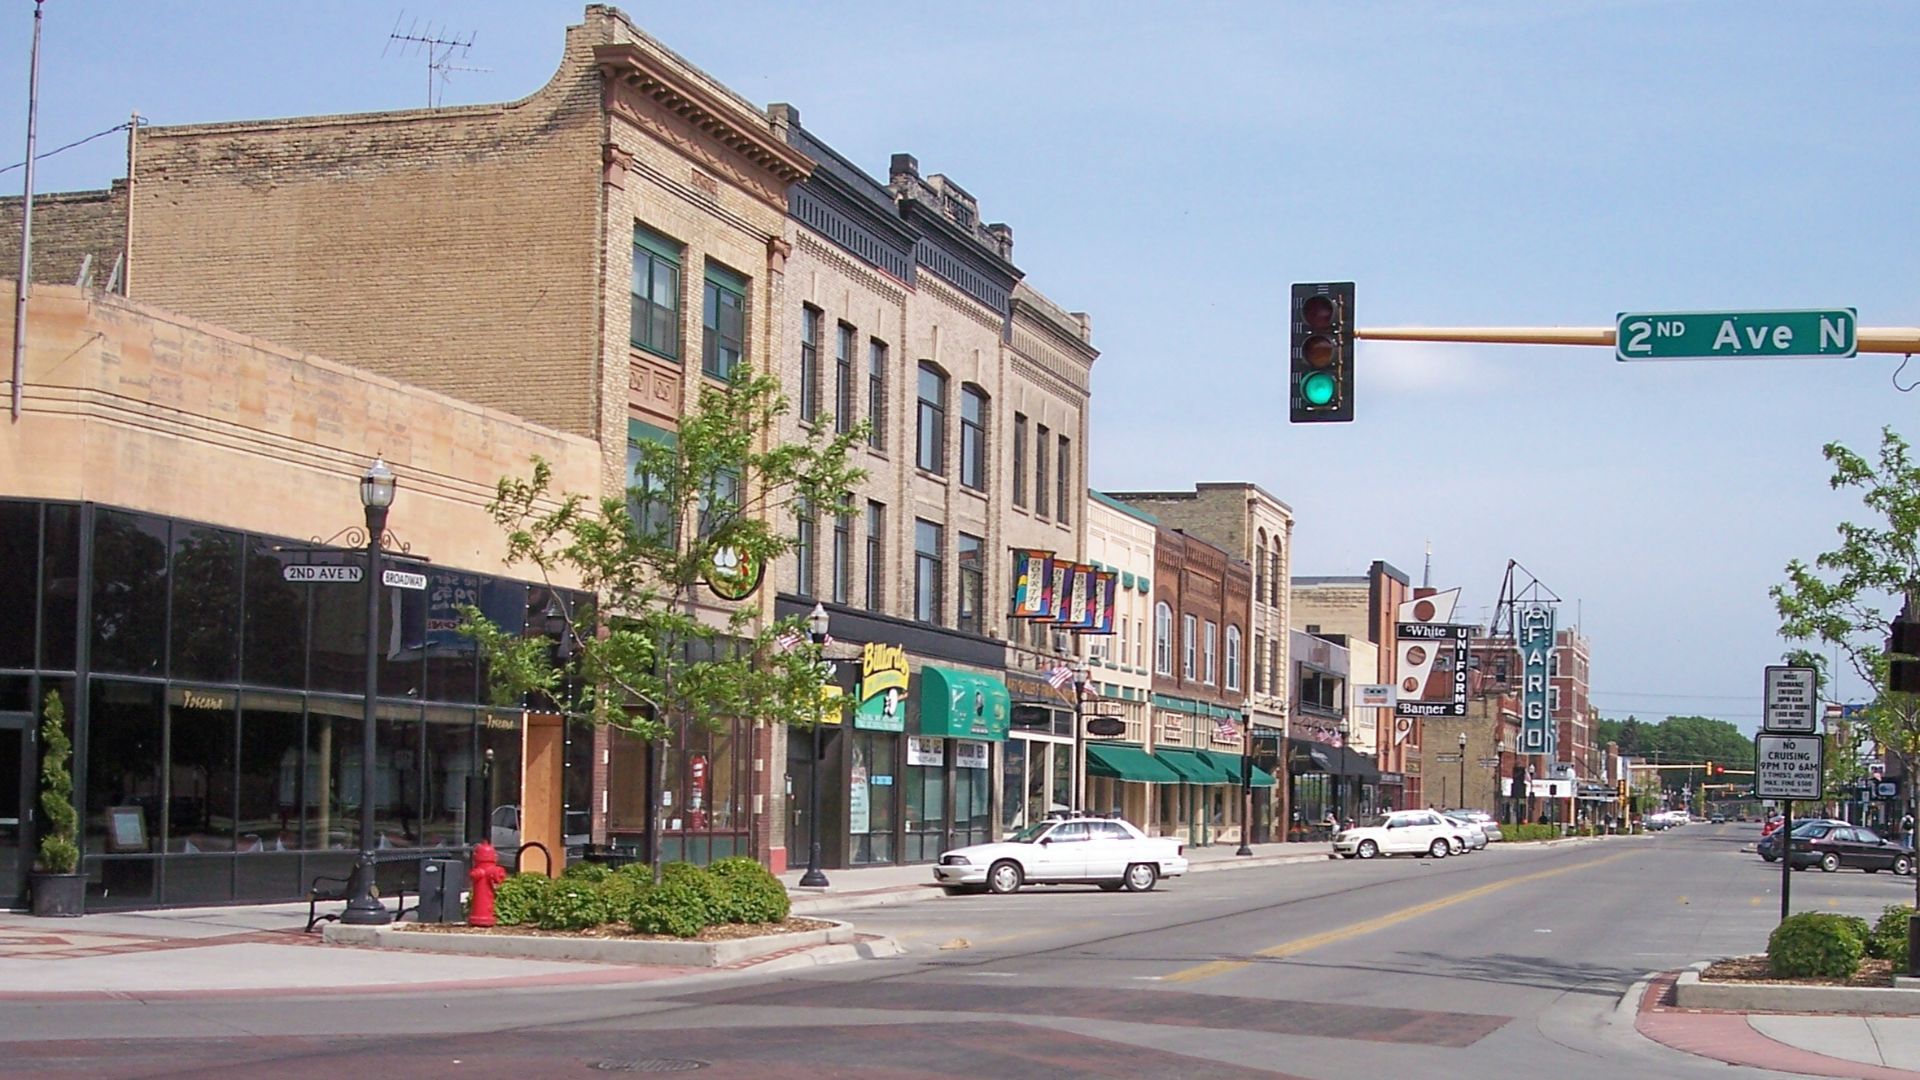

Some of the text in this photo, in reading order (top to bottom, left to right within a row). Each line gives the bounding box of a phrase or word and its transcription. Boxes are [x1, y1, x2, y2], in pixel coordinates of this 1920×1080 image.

[1626, 317, 1846, 351] 2ND Ave N
[289, 567, 359, 579] 2ND AVE N
[385, 572, 425, 587] BROADWAY
[1406, 625, 1447, 638] White
[862, 642, 909, 678] Billiards
[1454, 628, 1467, 715] UNIFORMS
[1527, 625, 1544, 747] FARGO
[1399, 703, 1446, 716] Banner
[1783, 741, 1796, 750] NO
[1768, 751, 1810, 761] CRUISING
[1760, 761, 1818, 771] 9PM TO 6AM
[1794, 772, 1815, 780] HOURS
